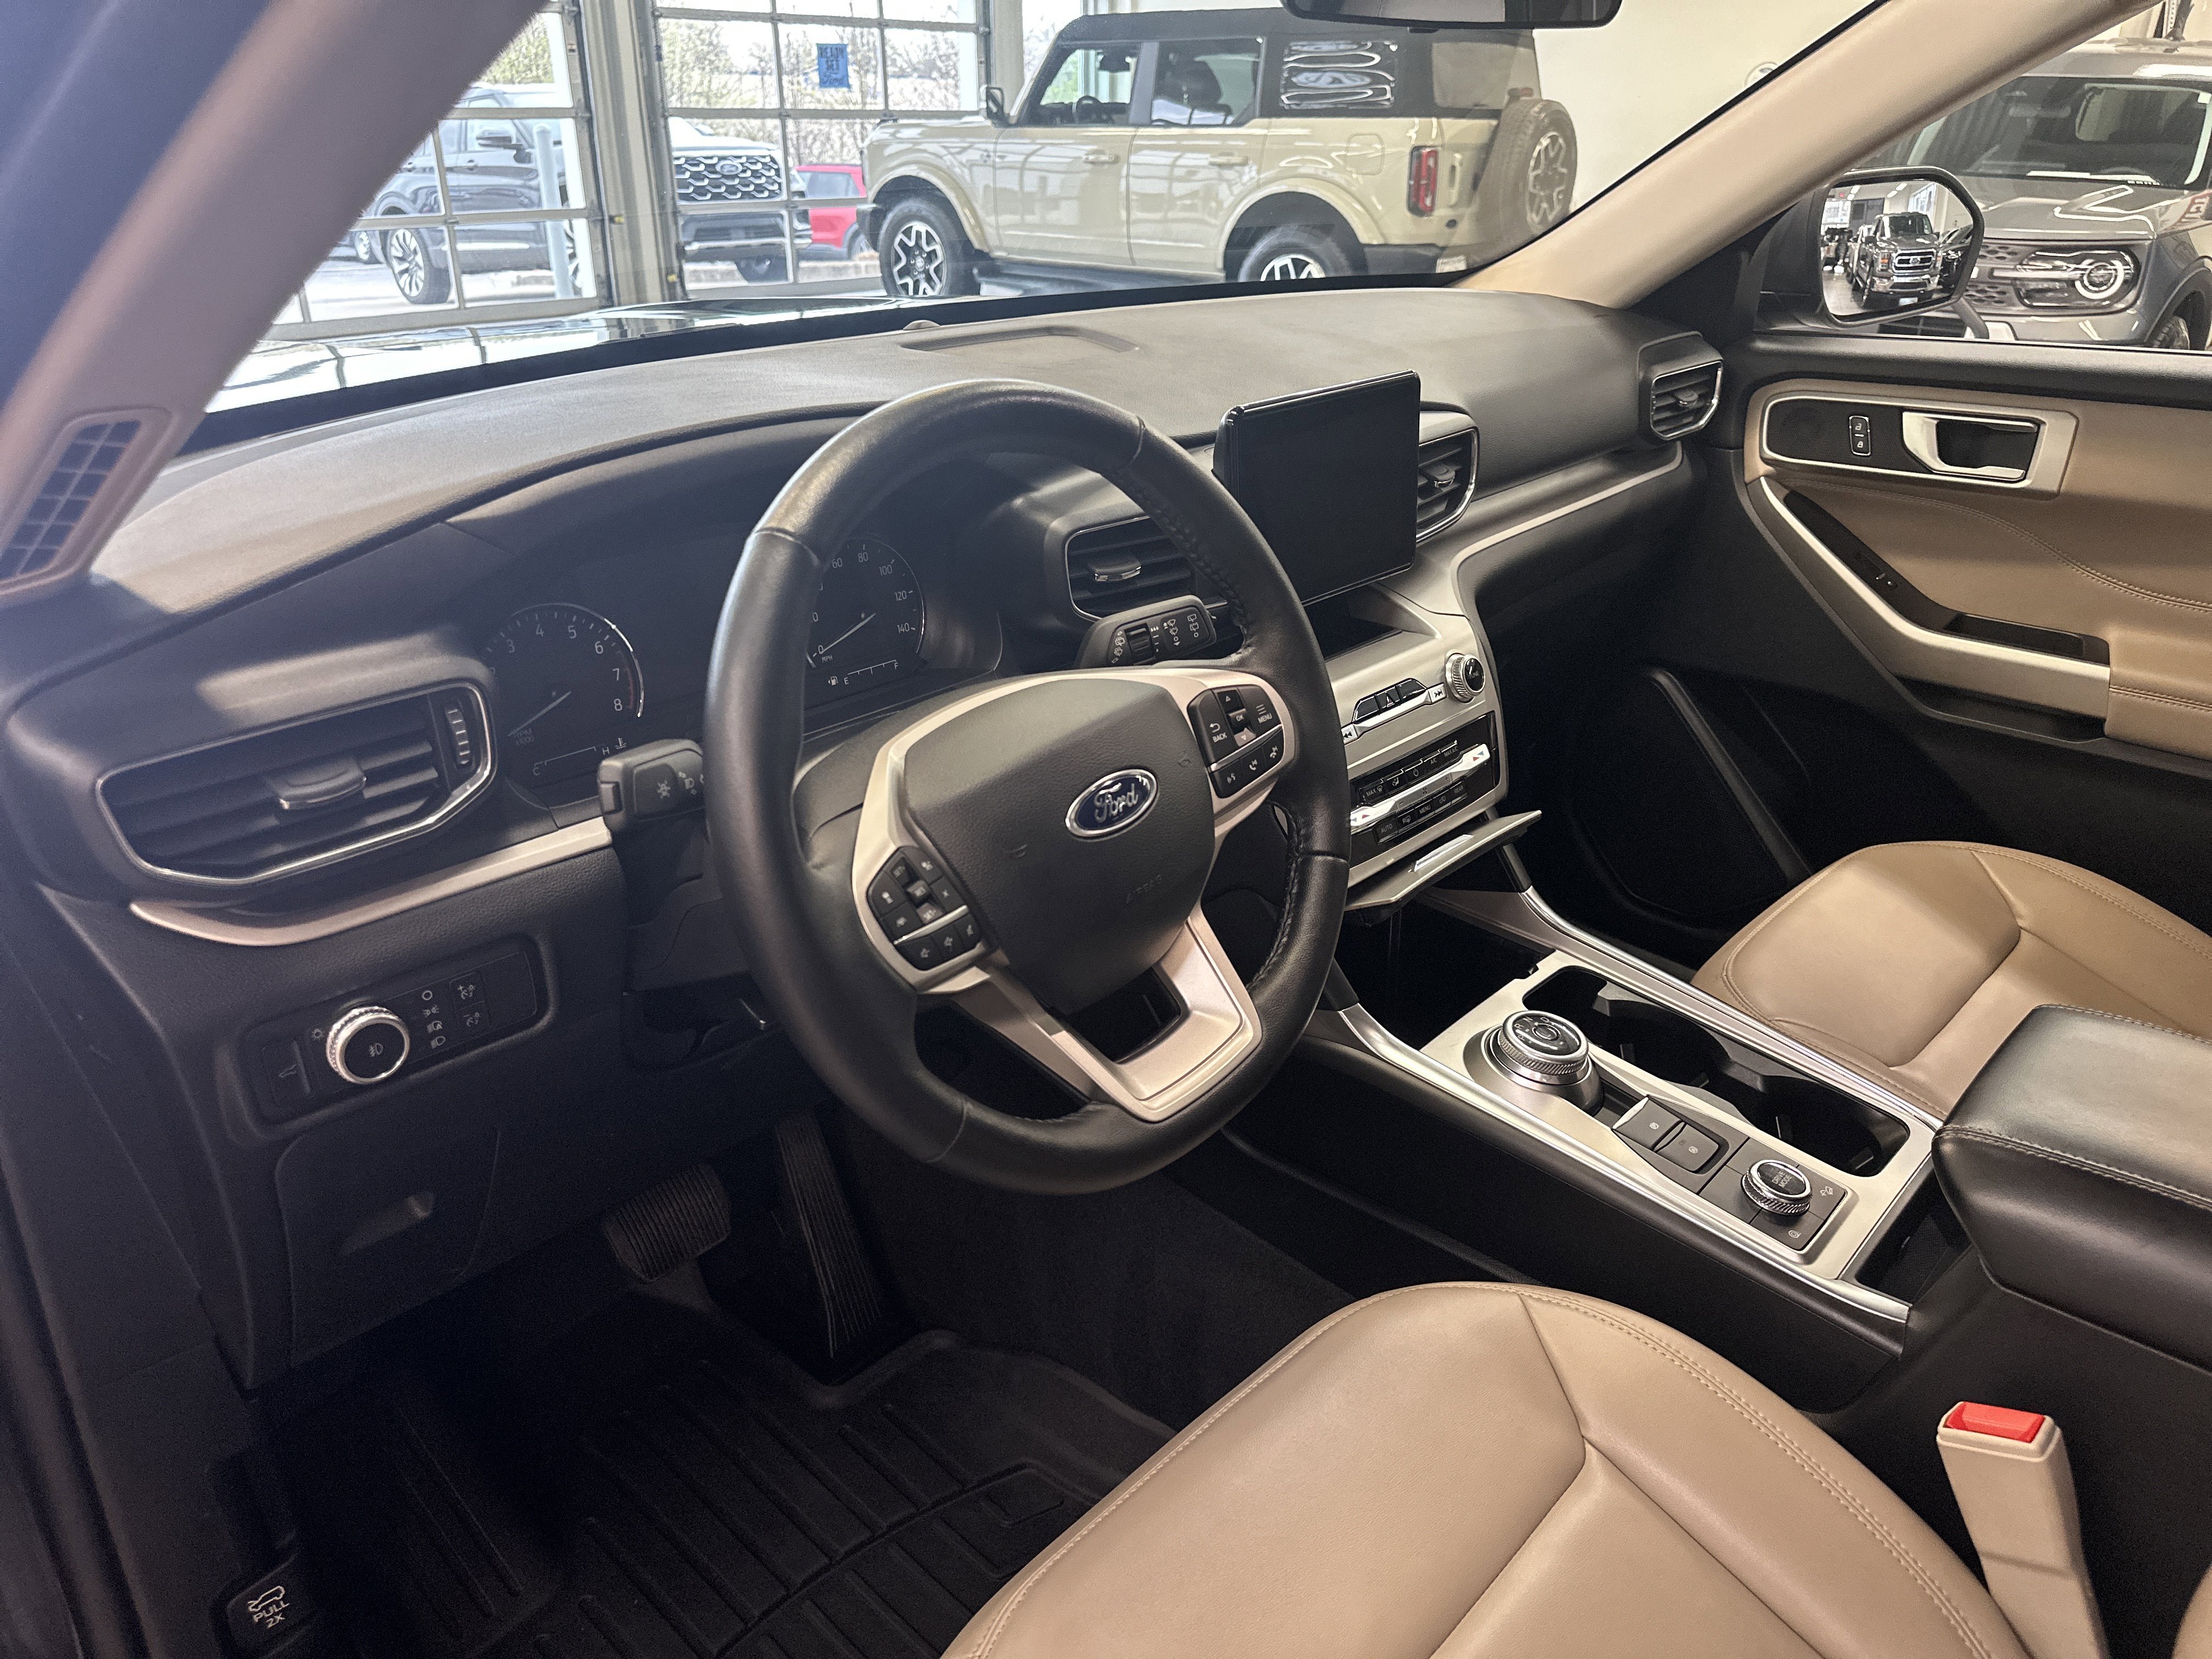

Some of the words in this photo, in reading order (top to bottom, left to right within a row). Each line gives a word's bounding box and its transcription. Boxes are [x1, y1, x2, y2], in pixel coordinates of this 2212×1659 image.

[832, 557, 843, 568] 60
[857, 552, 868, 563] 80
[879, 565, 893, 576] 100
[895, 590, 907, 601] 120
[535, 624, 544, 637] 4
[568, 625, 577, 639] 5
[897, 623, 910, 634] 140
[506, 639, 515, 653] 3
[595, 641, 603, 654] 6
[818, 645, 823, 654] 0
[612, 668, 620, 681] 7
[1468, 670, 1480, 679] TUNE
[844, 677, 849, 685] E
[613, 698, 623, 712] 8
[1257, 713, 1273, 724] MENU
[1212, 733, 1228, 743] BACK
[602, 747, 610, 755] H
[533, 767, 540, 776] C
[1365, 788, 1376, 797] MAX
[1094, 782, 1139, 823] Ford
[1419, 804, 1431, 815] MENU
[1380, 823, 1393, 833] AUTO
[1771, 1170, 1786, 1184] DRIVE
[1778, 1175, 1792, 1188] MODE
[253, 1600, 290, 1622] PULL
[266, 1613, 285, 1628] 2X
